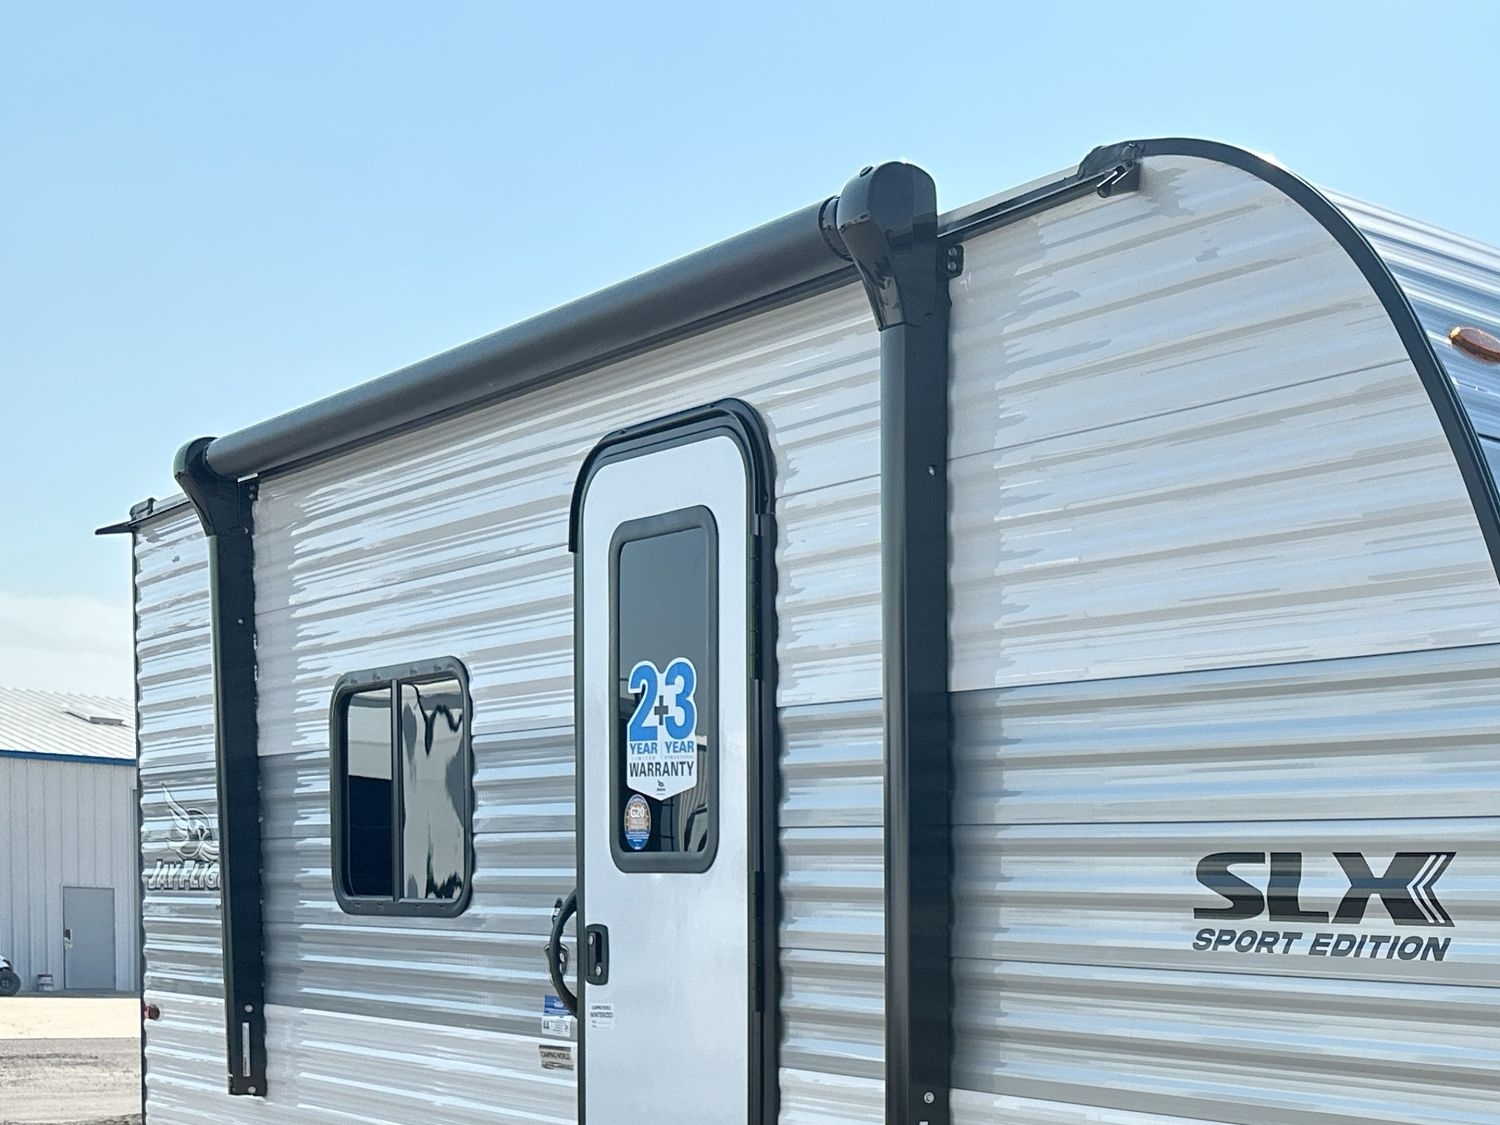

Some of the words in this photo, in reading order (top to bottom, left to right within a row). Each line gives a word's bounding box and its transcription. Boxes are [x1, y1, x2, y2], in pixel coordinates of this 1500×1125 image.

[630, 742, 658, 754] YEAR
[665, 741, 694, 754] YEAR
[630, 761, 694, 777] WARRANTY
[1193, 852, 1457, 927] SLX
[1192, 928, 1303, 955] SPORT
[1308, 933, 1452, 962] EDITION
